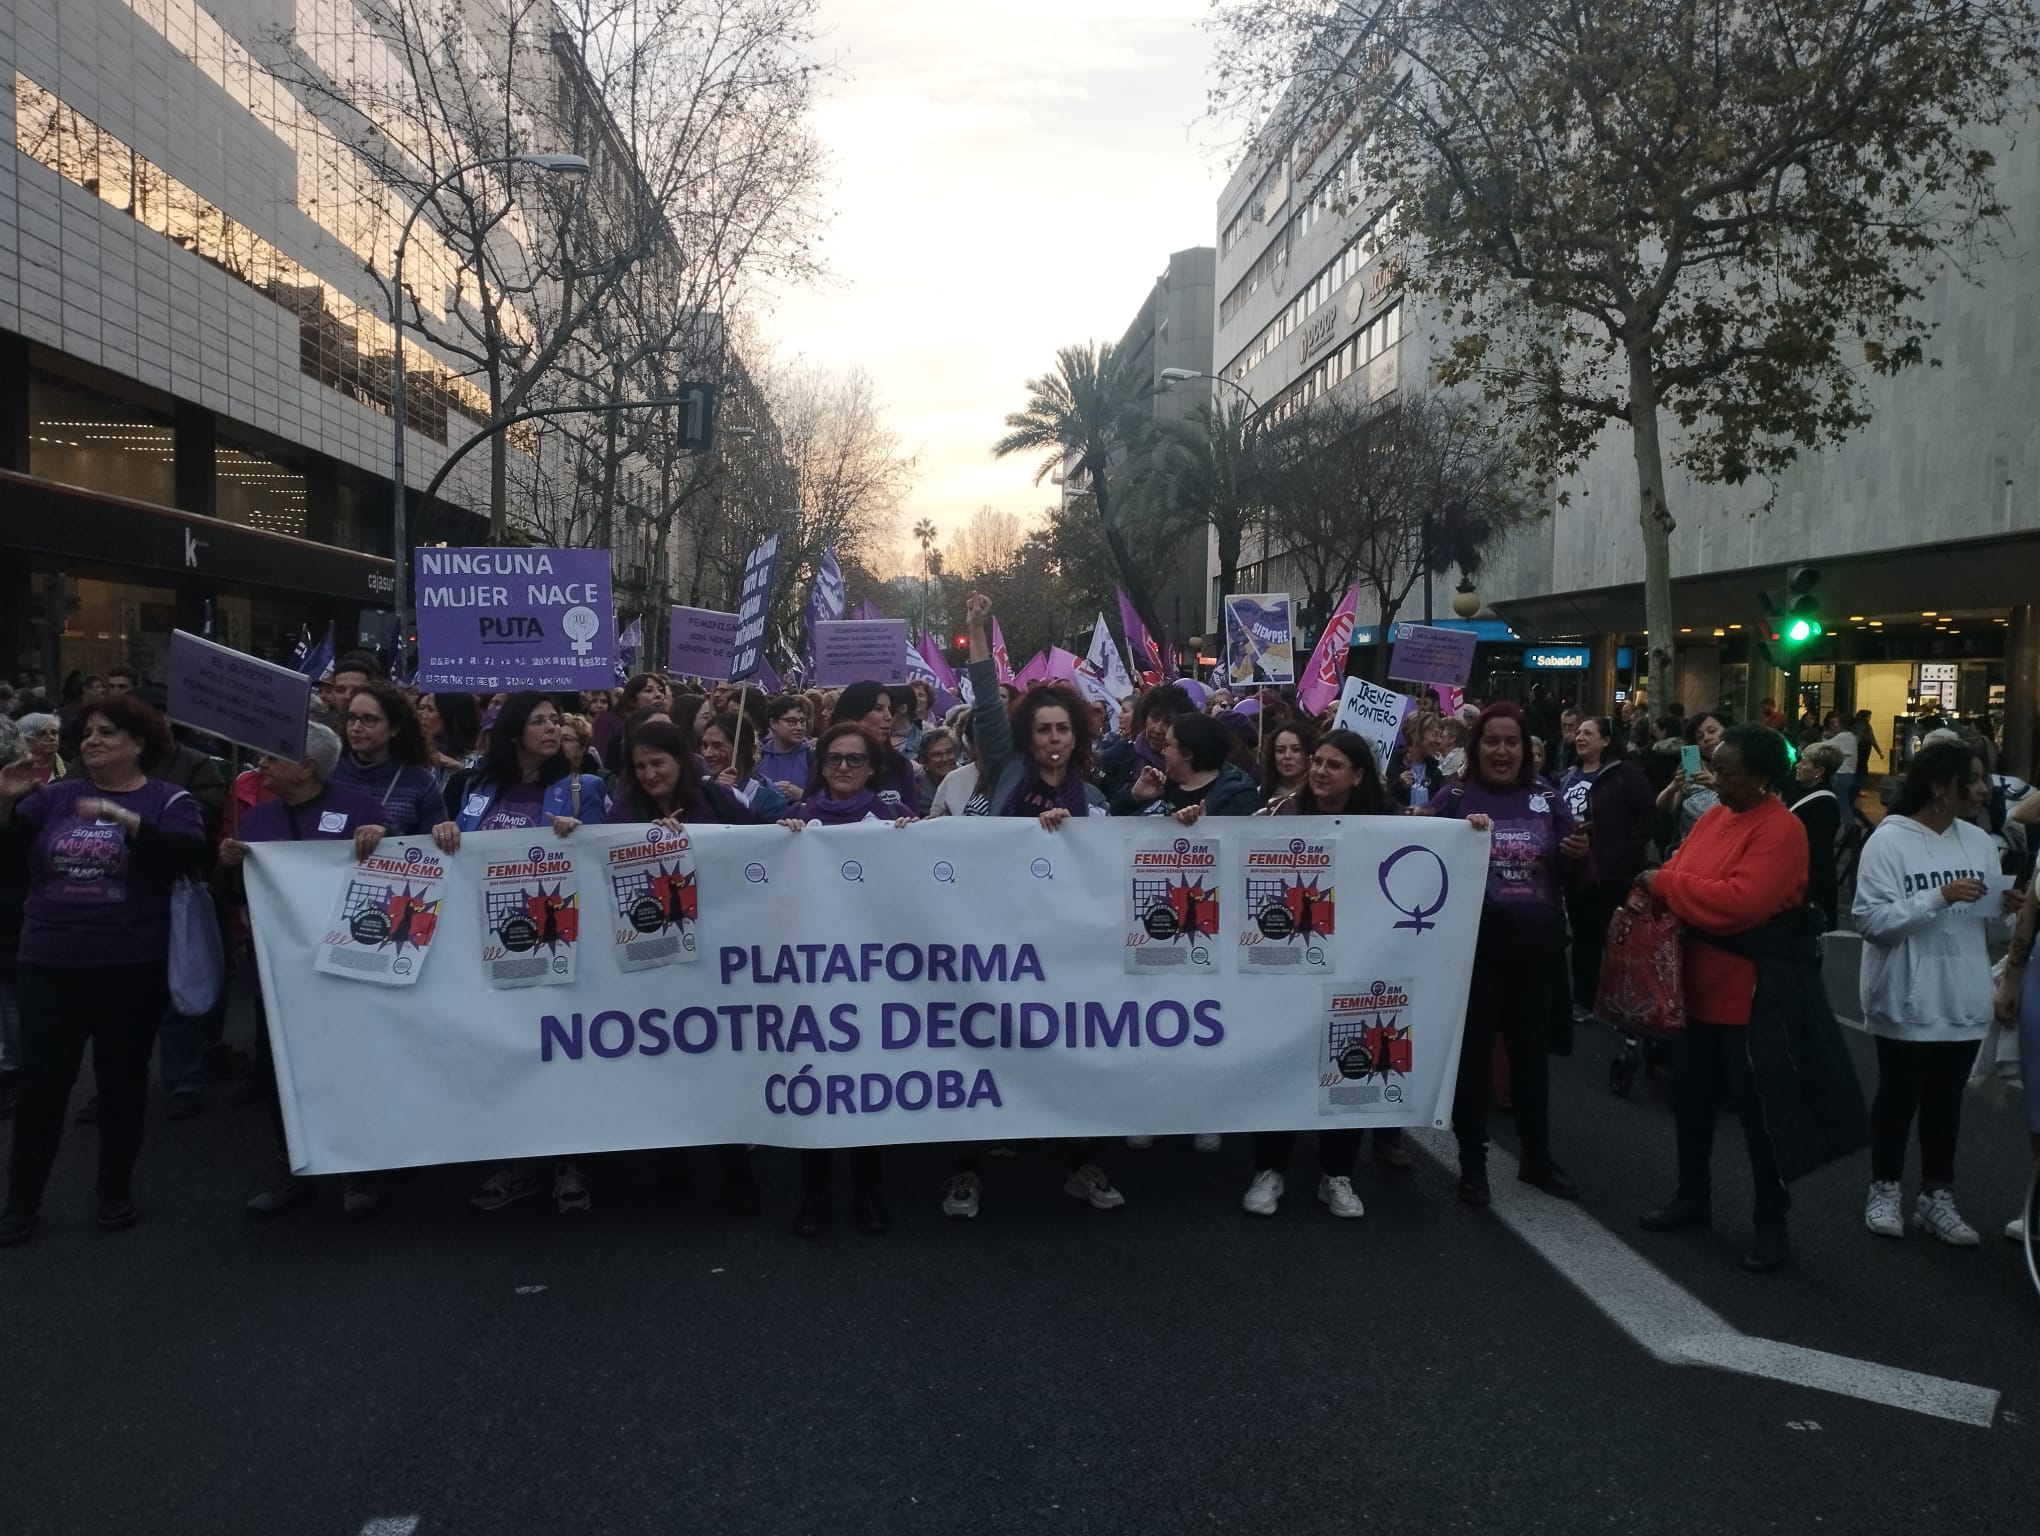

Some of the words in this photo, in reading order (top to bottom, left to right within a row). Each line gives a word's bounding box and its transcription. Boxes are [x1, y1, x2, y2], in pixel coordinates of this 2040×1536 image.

[422, 553, 554, 575] NINGUNA
[368, 570, 394, 593] cajasur
[423, 586, 508, 608] MUJER
[528, 583, 598, 606] NACE
[480, 616, 544, 638] PUTA
[1252, 622, 1288, 643] SIEMPRE
[1537, 655, 1583, 667] Sabadell
[1357, 681, 1397, 707] IRENE
[1347, 697, 1397, 726] MONTERO
[71, 828, 113, 839] SOMOS
[547, 852, 564, 860] 8M
[610, 838, 689, 861] FEMINISMO
[1192, 845, 1208, 853] 8M
[1307, 846, 1324, 854] 8M
[424, 856, 440, 865] 8M
[488, 861, 571, 876] FEMINISMO
[1134, 854, 1214, 866] FEMINISMO
[1248, 854, 1330, 866] FEMINISMO
[720, 942, 1046, 985] PLATAFORMA
[1387, 986, 1402, 994] 8M
[1332, 994, 1408, 1009] FEMINISMO
[541, 1003, 861, 1063] NOSOTRAS
[880, 1000, 1225, 1050] DECIDIMOS
[765, 1064, 1002, 1116] CÓRDOBA
